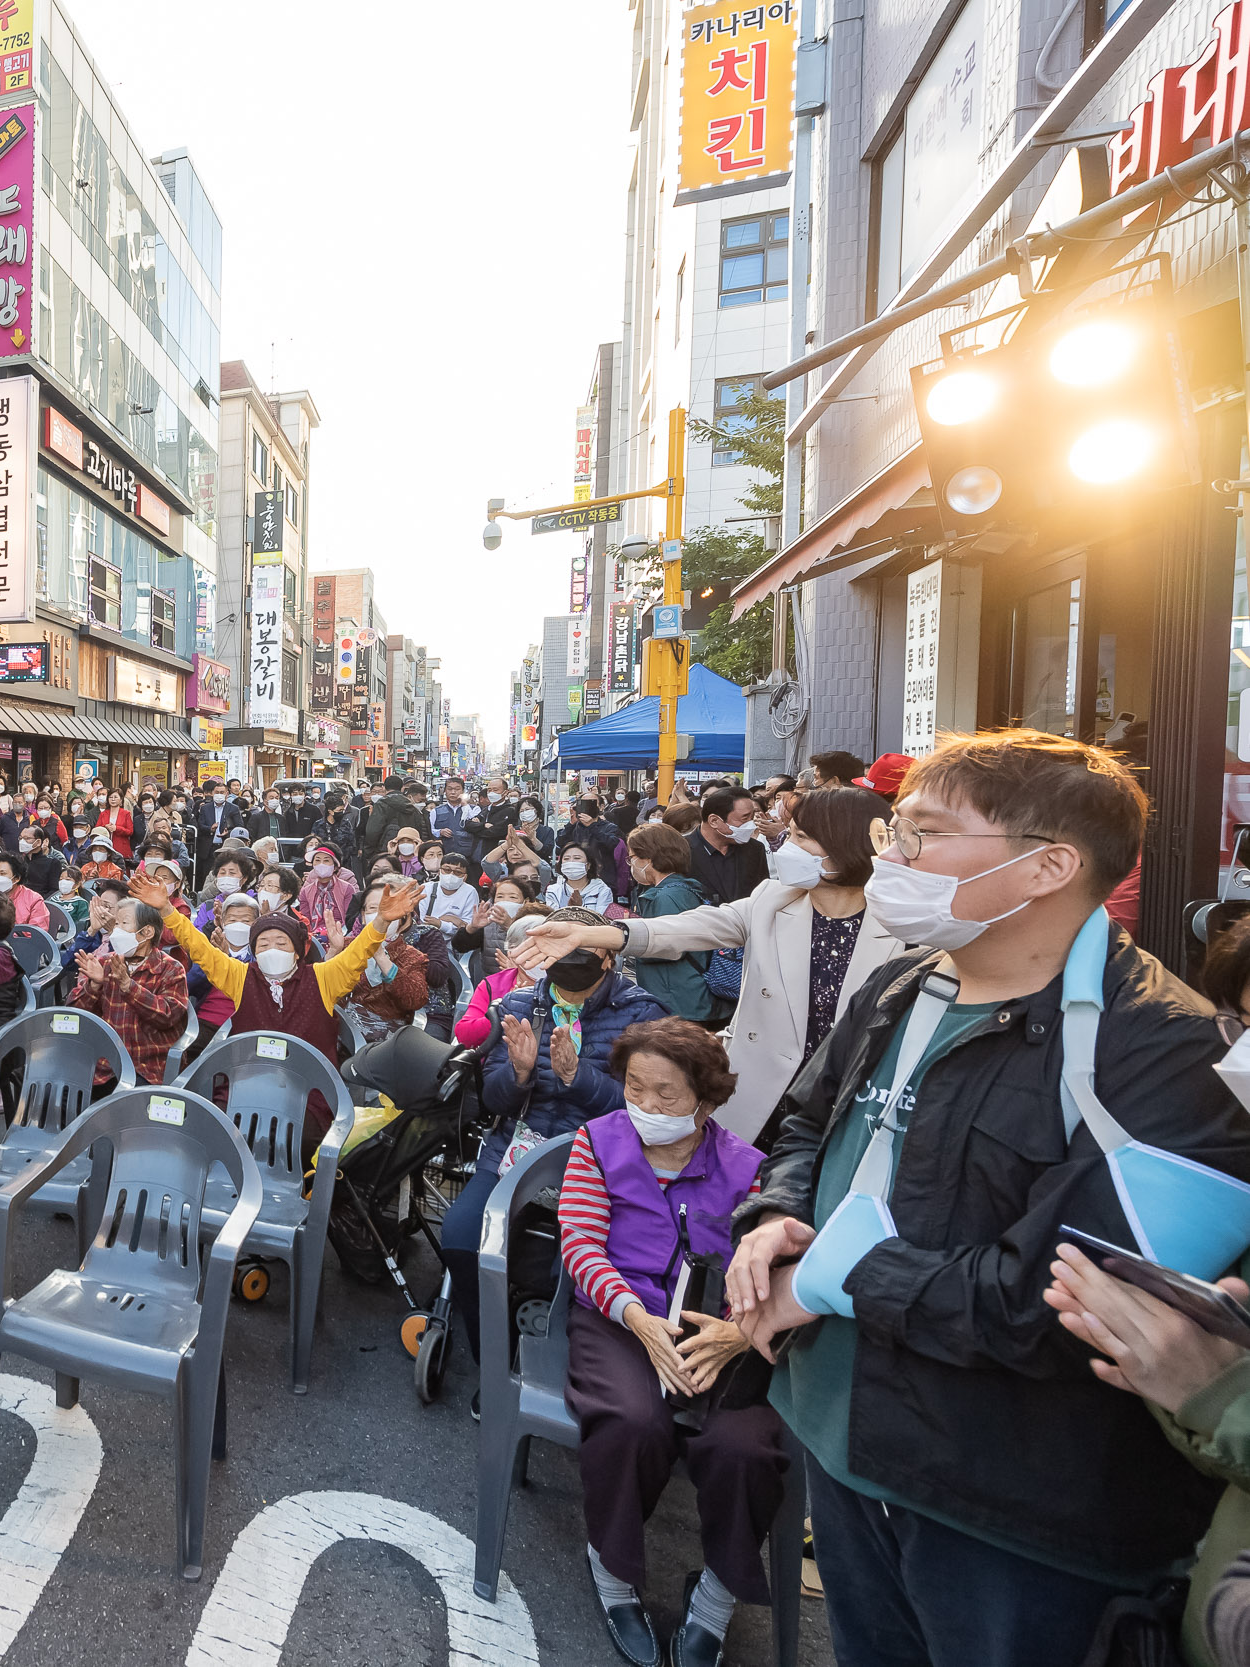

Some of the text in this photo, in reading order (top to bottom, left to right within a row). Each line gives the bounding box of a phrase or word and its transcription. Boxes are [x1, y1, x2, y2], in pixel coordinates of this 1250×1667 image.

[691, 1, 794, 43] 카나리아
[4, 53, 30, 75] 생고기
[10, 75, 24, 87] 2F
[706, 41, 768, 172] 치킨
[87, 440, 137, 512] 고기마루
[576, 428, 591, 474] 마사지
[558, 506, 618, 527] CCTV 작동중
[254, 611, 278, 700] 대봉갈비
[314, 636, 332, 702] 노래방
[613, 616, 630, 673] 강남촌닭
